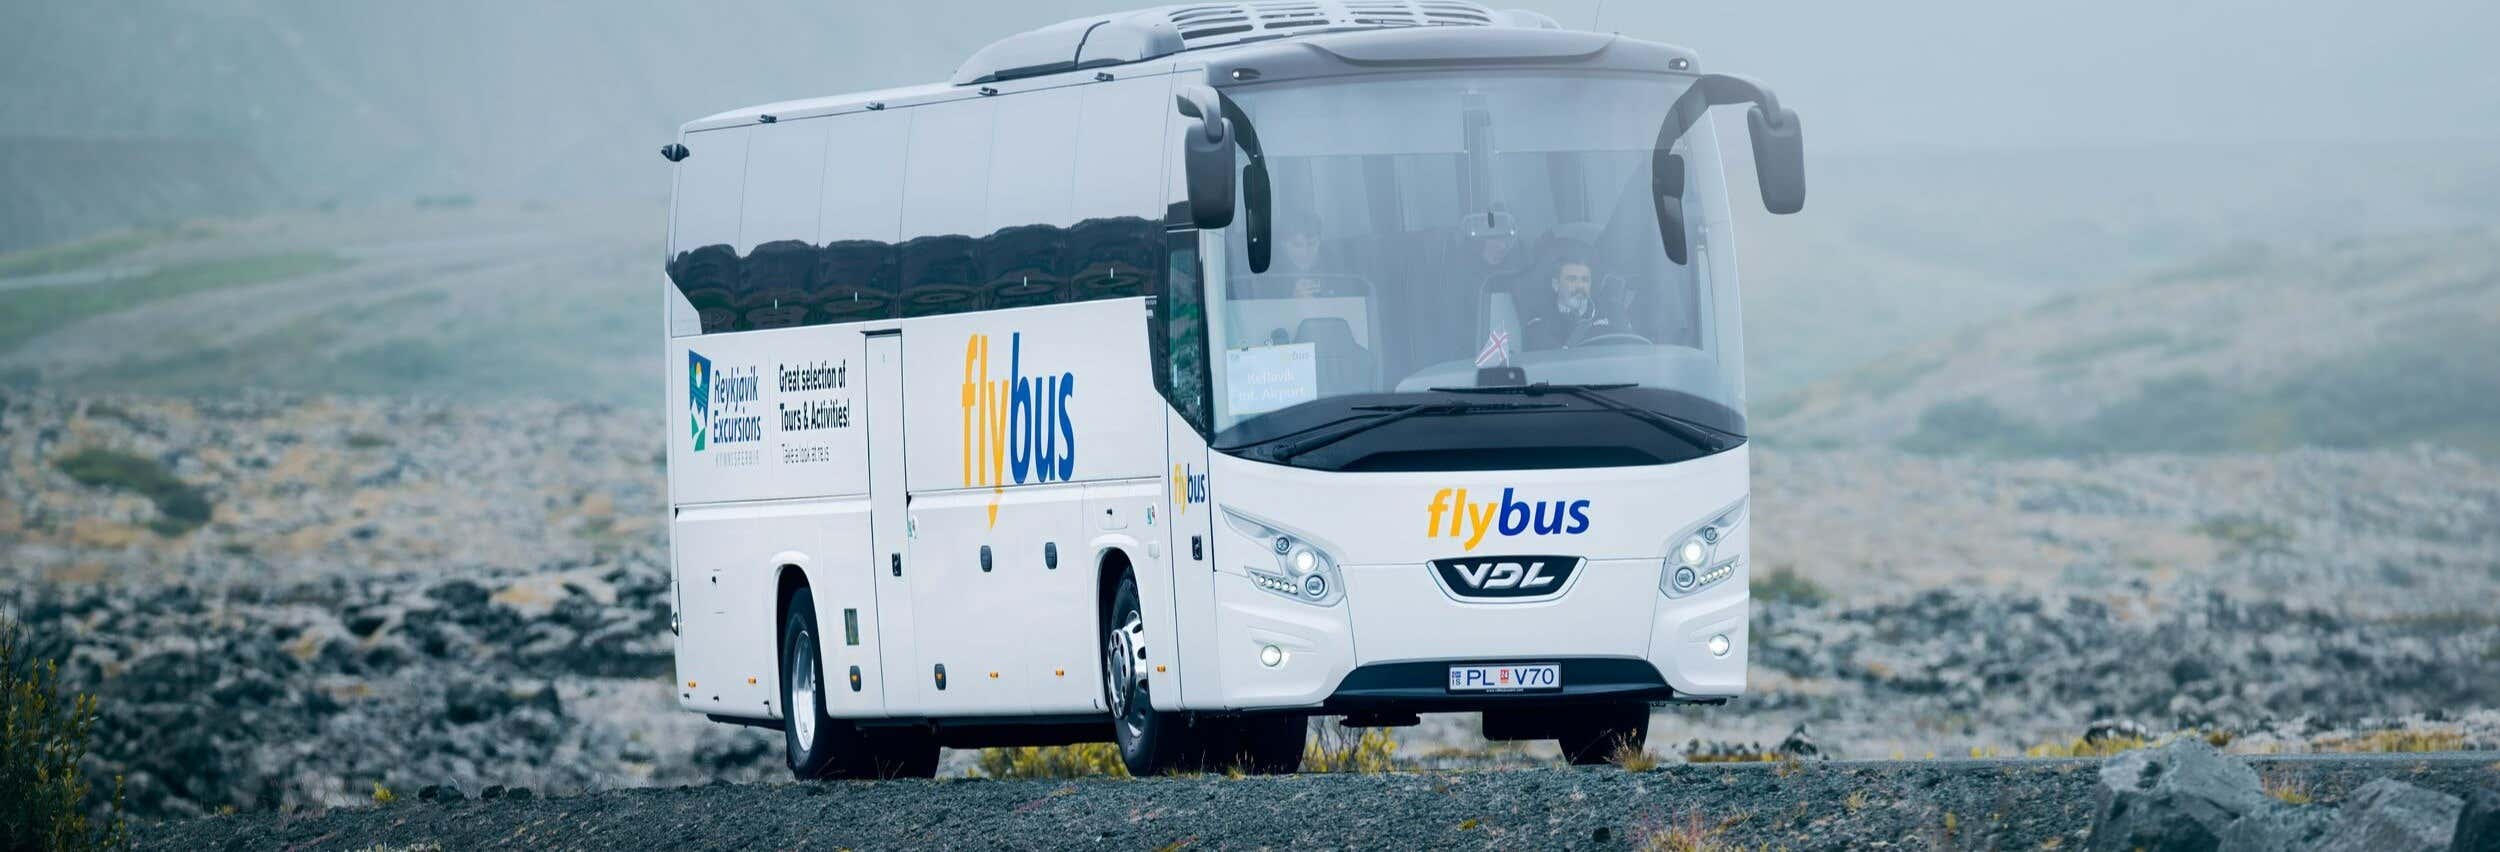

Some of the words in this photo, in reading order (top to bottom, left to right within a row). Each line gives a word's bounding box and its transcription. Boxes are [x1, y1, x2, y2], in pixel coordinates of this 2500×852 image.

[713, 366, 759, 412] Reykjavik
[779, 363, 800, 393] Great
[801, 362, 837, 392] selection
[838, 359, 847, 389] of
[713, 410, 761, 444] Excursions
[779, 402, 801, 432] Tours
[803, 402, 809, 430] &
[811, 398, 851, 429] Activities!
[961, 331, 1075, 530] flybus
[1173, 462, 1206, 516] flybus
[1427, 487, 1591, 552] flybus
[1453, 562, 1555, 590] VDL
[1466, 669, 1496, 686] PL
[1514, 667, 1555, 685] V70
